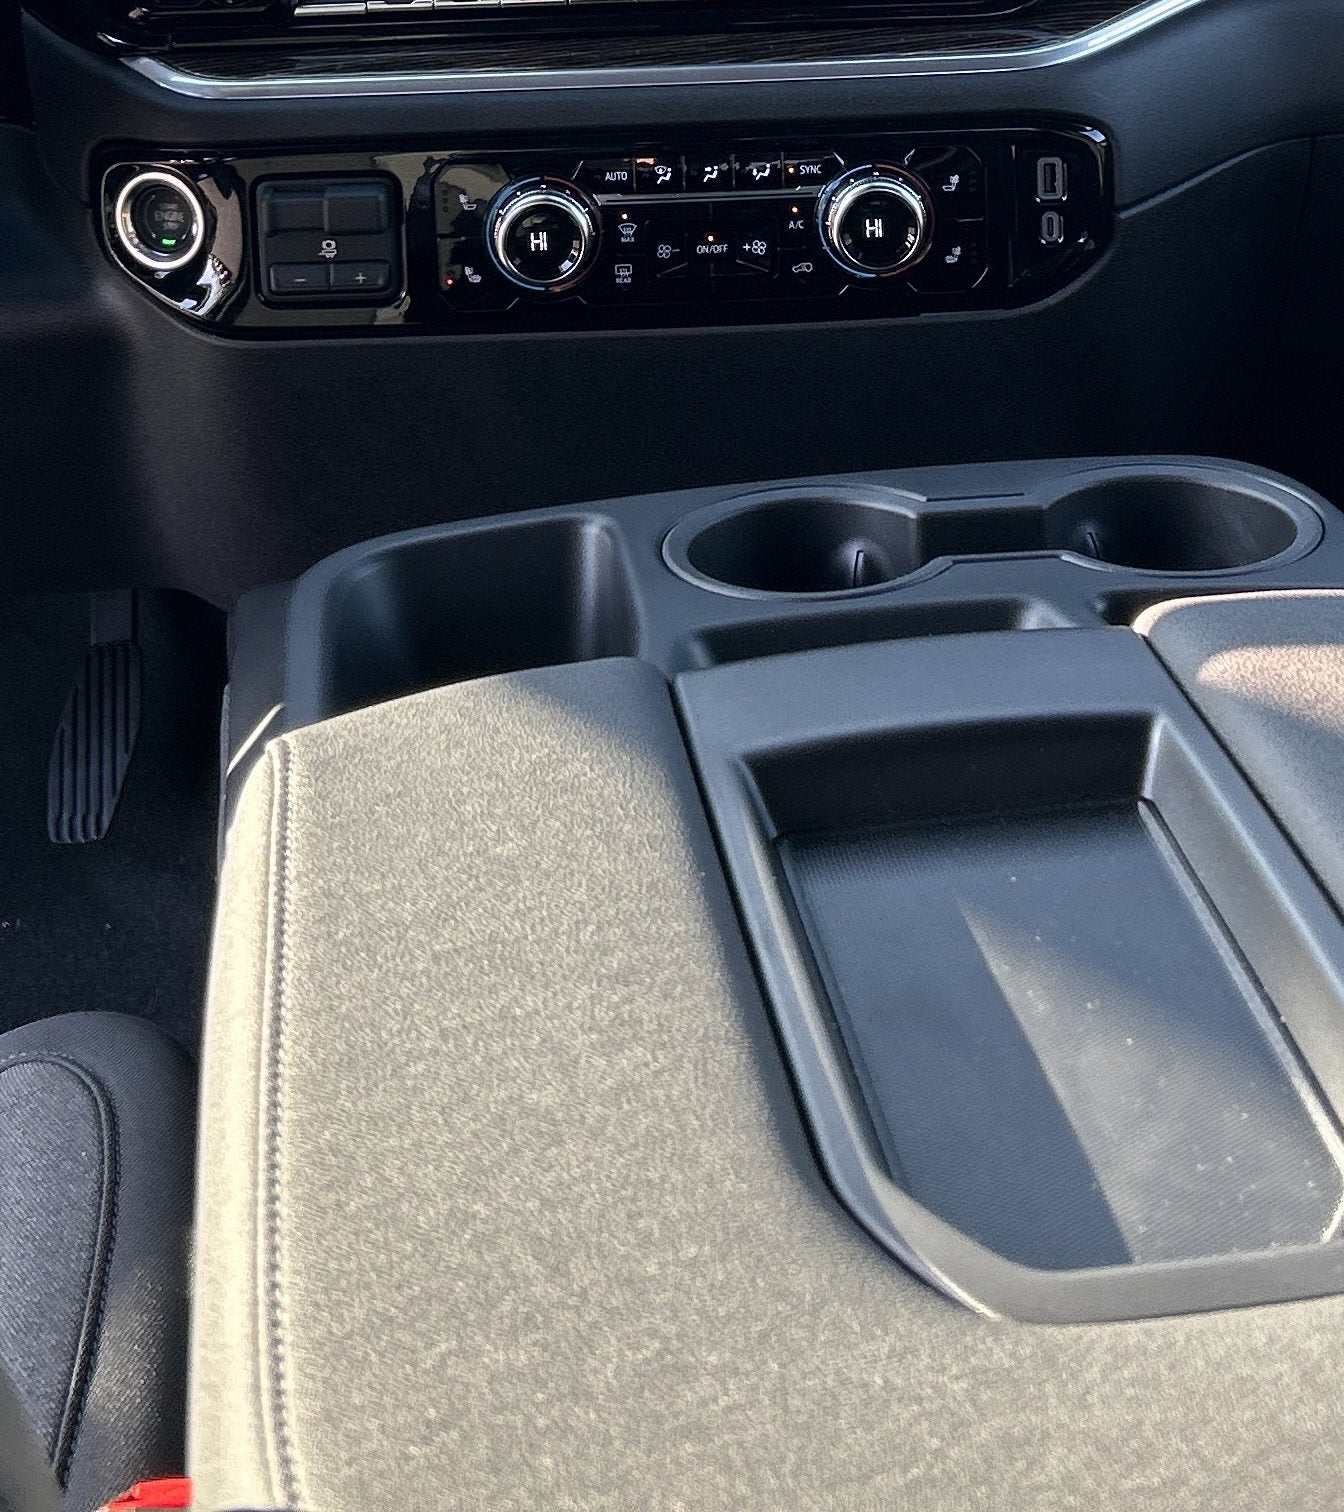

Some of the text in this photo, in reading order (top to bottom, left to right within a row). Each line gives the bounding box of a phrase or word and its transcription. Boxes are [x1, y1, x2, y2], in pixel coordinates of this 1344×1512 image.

[799, 164, 822, 175] SYNC
[605, 171, 628, 181] AUTO
[788, 219, 805, 230] A/C
[865, 218, 883, 238] HI
[530, 231, 548, 252] HI
[696, 243, 729, 254] ON/OFF
